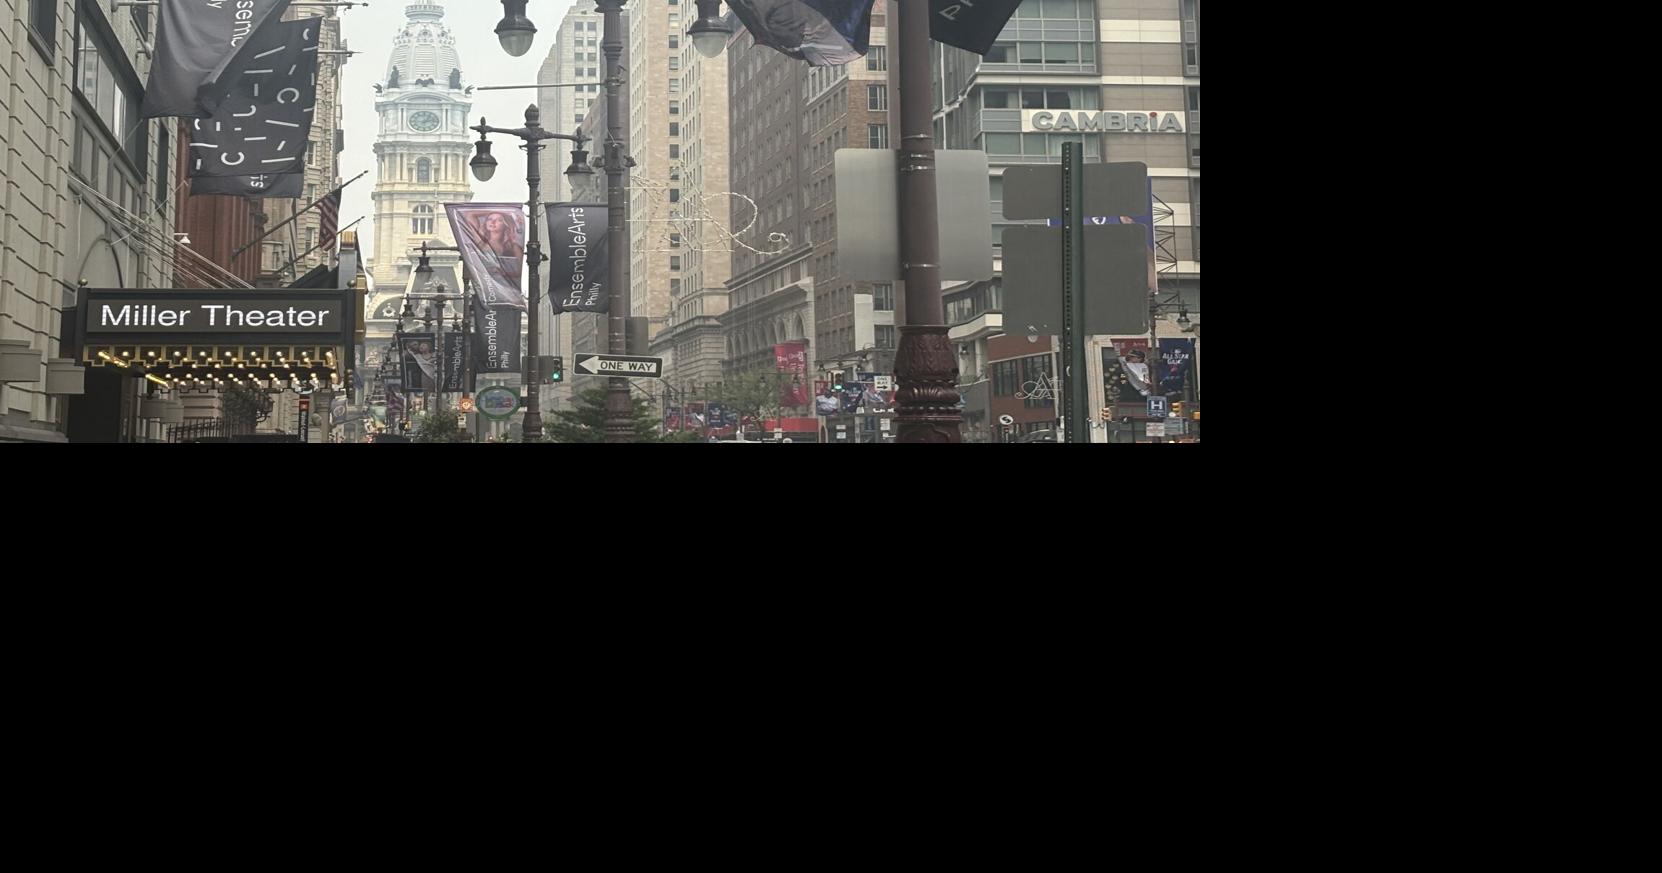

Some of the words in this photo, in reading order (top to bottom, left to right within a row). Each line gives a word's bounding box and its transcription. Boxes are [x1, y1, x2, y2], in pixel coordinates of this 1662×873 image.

[562, 207, 587, 307] EnsembleArts
[585, 282, 602, 306] Philly
[101, 304, 191, 327] Miller
[201, 304, 330, 327] Theater
[500, 351, 510, 369] Philly
[600, 361, 624, 371] ONE
[628, 362, 654, 372] WAY
[1150, 400, 1163, 410] H
